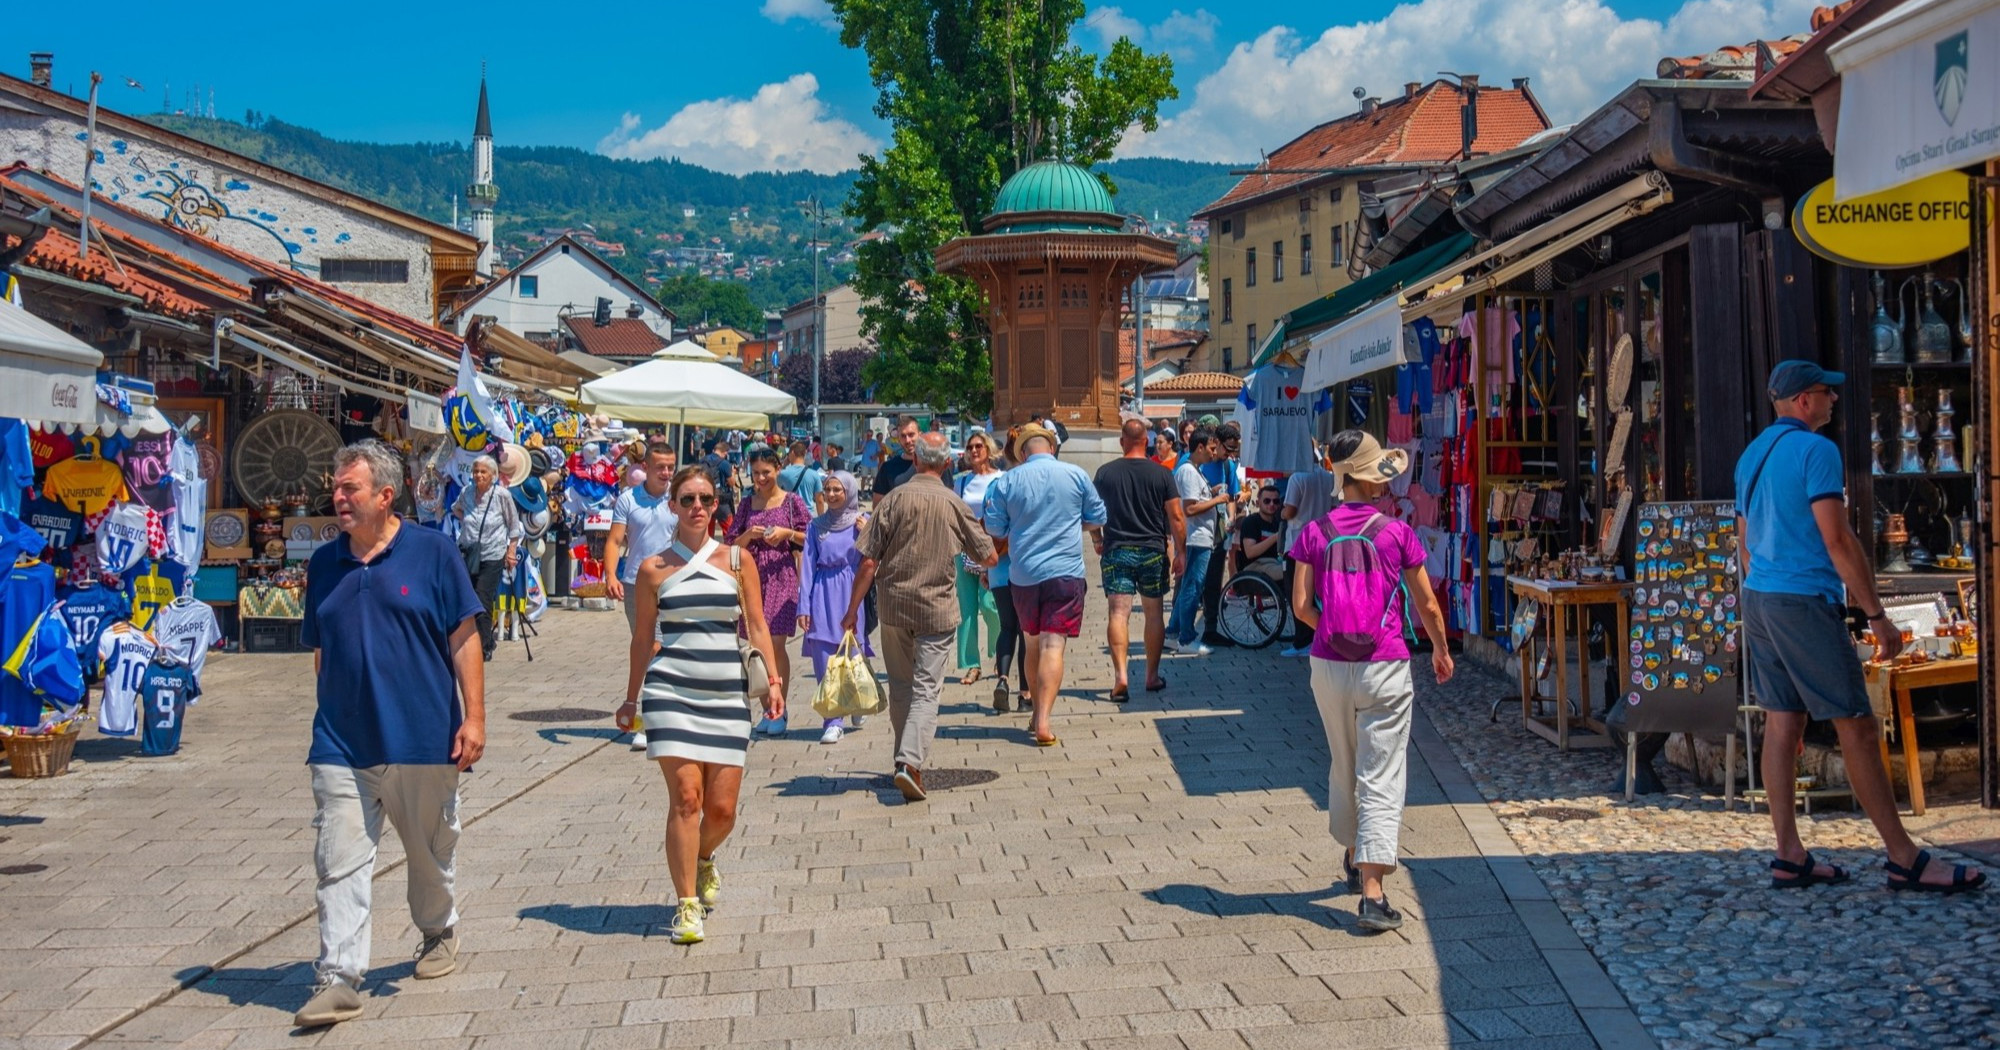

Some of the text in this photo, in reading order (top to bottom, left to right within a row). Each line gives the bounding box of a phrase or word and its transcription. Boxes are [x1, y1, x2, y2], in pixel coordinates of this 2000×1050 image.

[1946, 130, 1968, 154] Grad
[1816, 200, 1970, 224] EXCHANGE OFFIC
[1277, 386, 1282, 400] I
[1263, 407, 1307, 417] SARAJEVO
[137, 440, 161, 452] ESSI
[129, 456, 165, 487] 10
[31, 514, 72, 530] GVARDIOL
[587, 514, 602, 524] 25
[136, 585, 170, 596] RONALDO
[68, 605, 96, 614] NEYMAR
[141, 602, 161, 631] 7
[73, 616, 100, 647] 10
[180, 637, 196, 666] 7
[121, 658, 147, 692] 10
[156, 690, 175, 728] 9
